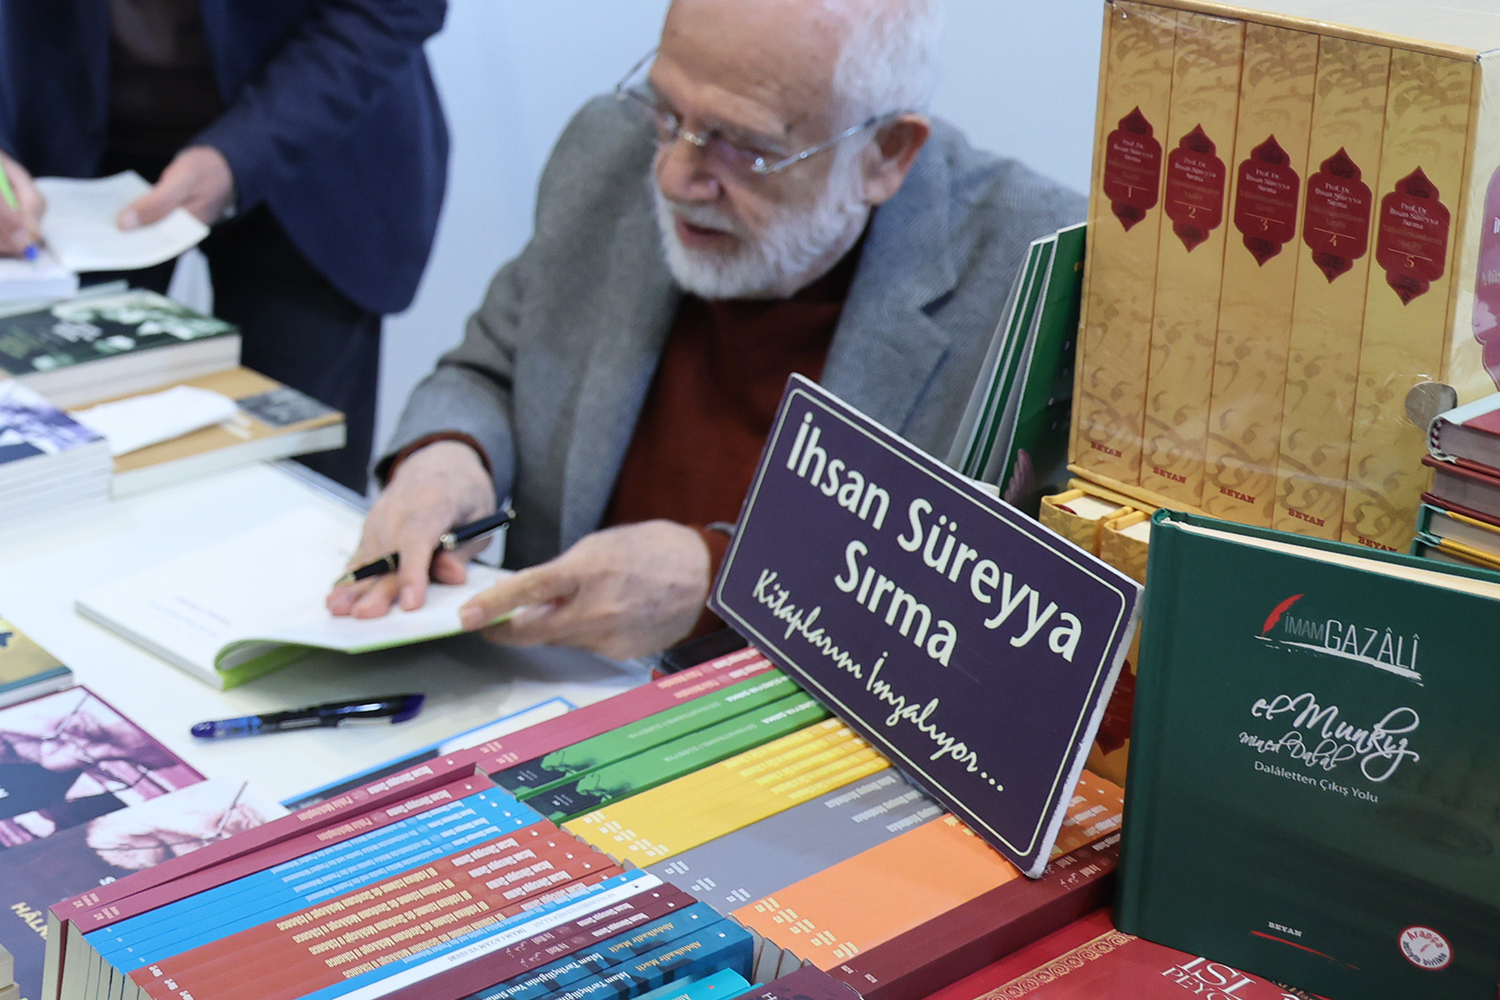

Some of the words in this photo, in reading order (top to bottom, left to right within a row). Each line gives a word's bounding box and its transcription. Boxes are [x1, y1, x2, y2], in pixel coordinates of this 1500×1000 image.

[1128, 187, 1132, 198] 1
[1188, 206, 1196, 219] 2
[1260, 219, 1268, 231] 3
[1329, 235, 1337, 246] 4
[1404, 255, 1415, 268] 5
[1090, 441, 1122, 458] BEYAN
[1153, 466, 1186, 484] BEYAN
[1220, 486, 1255, 505] BEYAN
[1288, 508, 1325, 527] BEYAN
[785, 412, 890, 530] İhsan
[897, 498, 1084, 663] Süreyya
[833, 540, 959, 668] Sırma
[752, 568, 863, 680] Kitaplarını
[865, 651, 1005, 792] İmzalıyor...
[1254, 760, 1317, 787] Dalâletten
[1319, 778, 1349, 796] Çıkış
[1351, 786, 1379, 803] Yolu
[628, 923, 676, 943] Abdulkadir
[1268, 921, 1302, 938] BEYAN
[607, 940, 633, 952] Macit
[1406, 930, 1444, 948] Arapça
[576, 953, 603, 966] İslam
[656, 941, 703, 961] Abdulkadir
[633, 959, 660, 971] Macit
[522, 961, 582, 987] Tarihçiliğinin
[602, 971, 630, 984] İslam
[505, 984, 527, 994] Yeni
